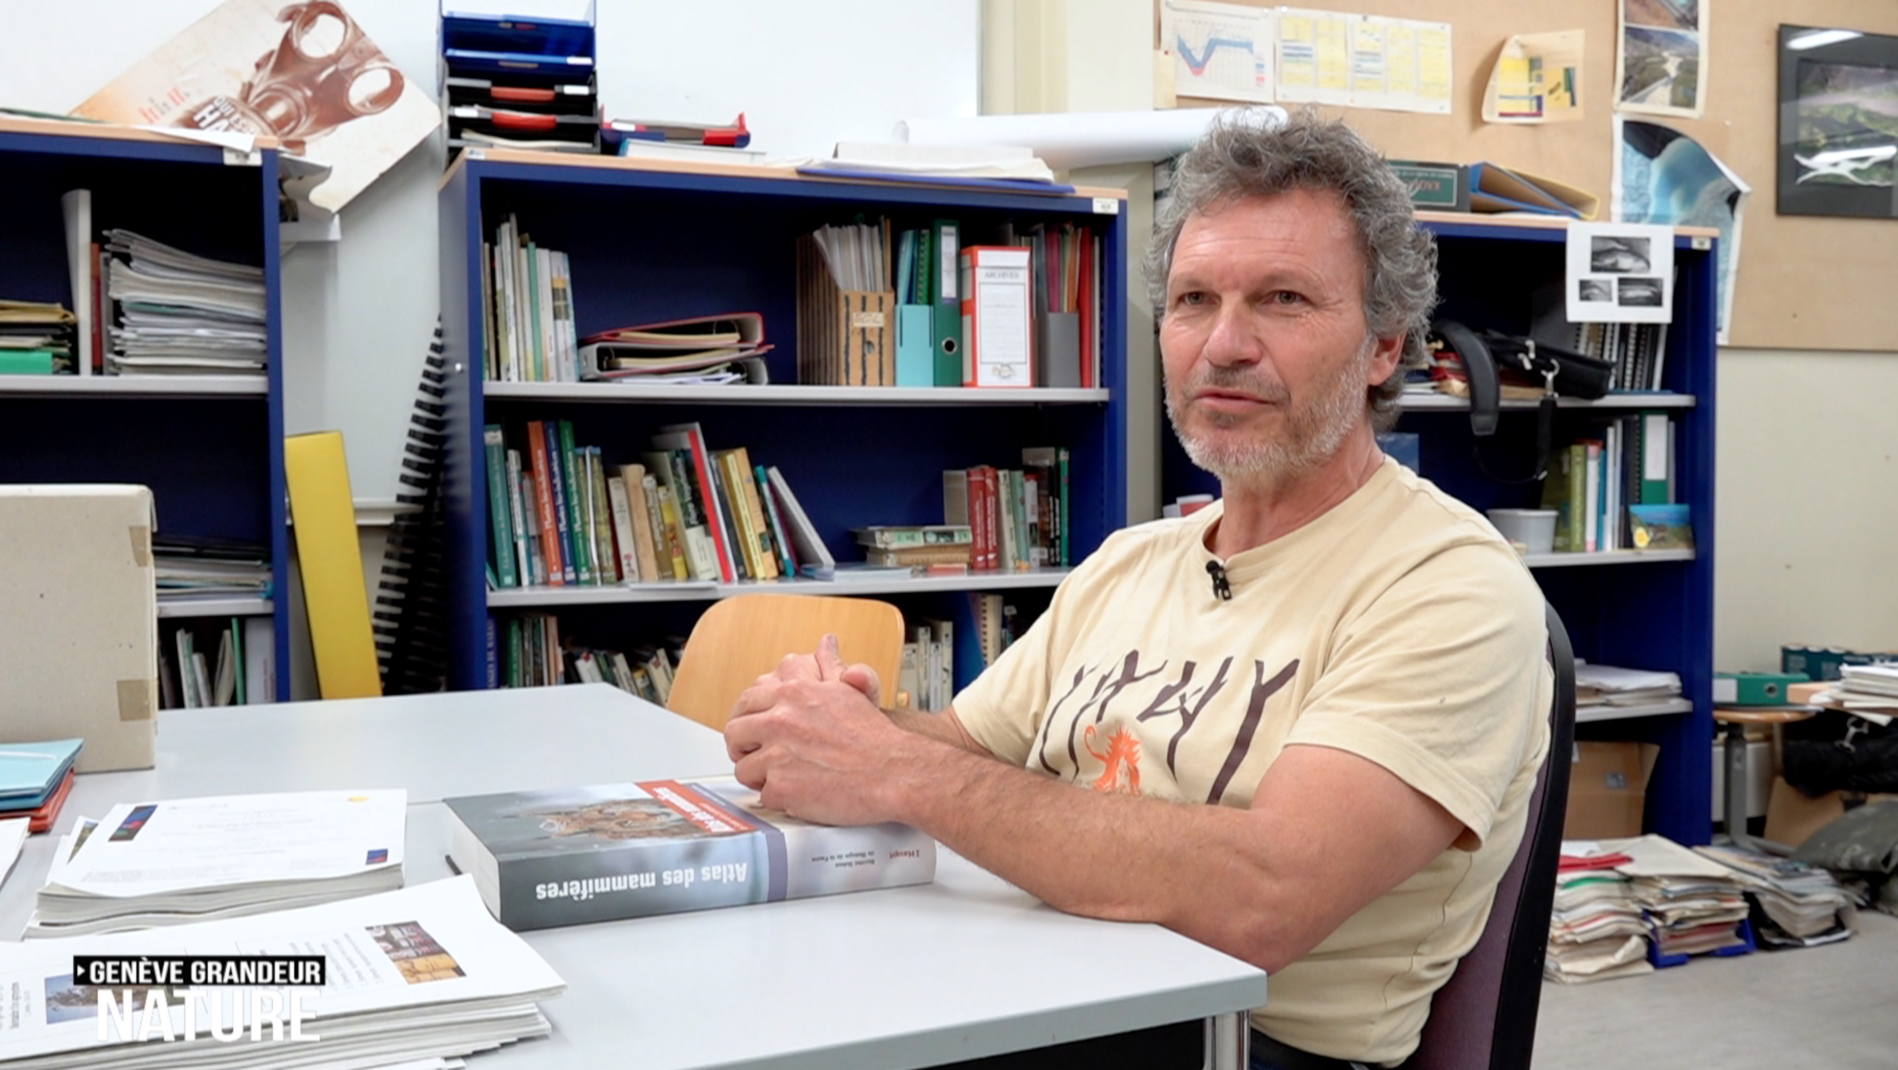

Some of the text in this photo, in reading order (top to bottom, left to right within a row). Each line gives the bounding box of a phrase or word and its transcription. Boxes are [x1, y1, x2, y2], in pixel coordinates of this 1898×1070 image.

[984, 271, 1020, 280] ARCHIVES
[889, 850, 915, 859] Haupt
[535, 862, 748, 901] Atlas des mammifères
